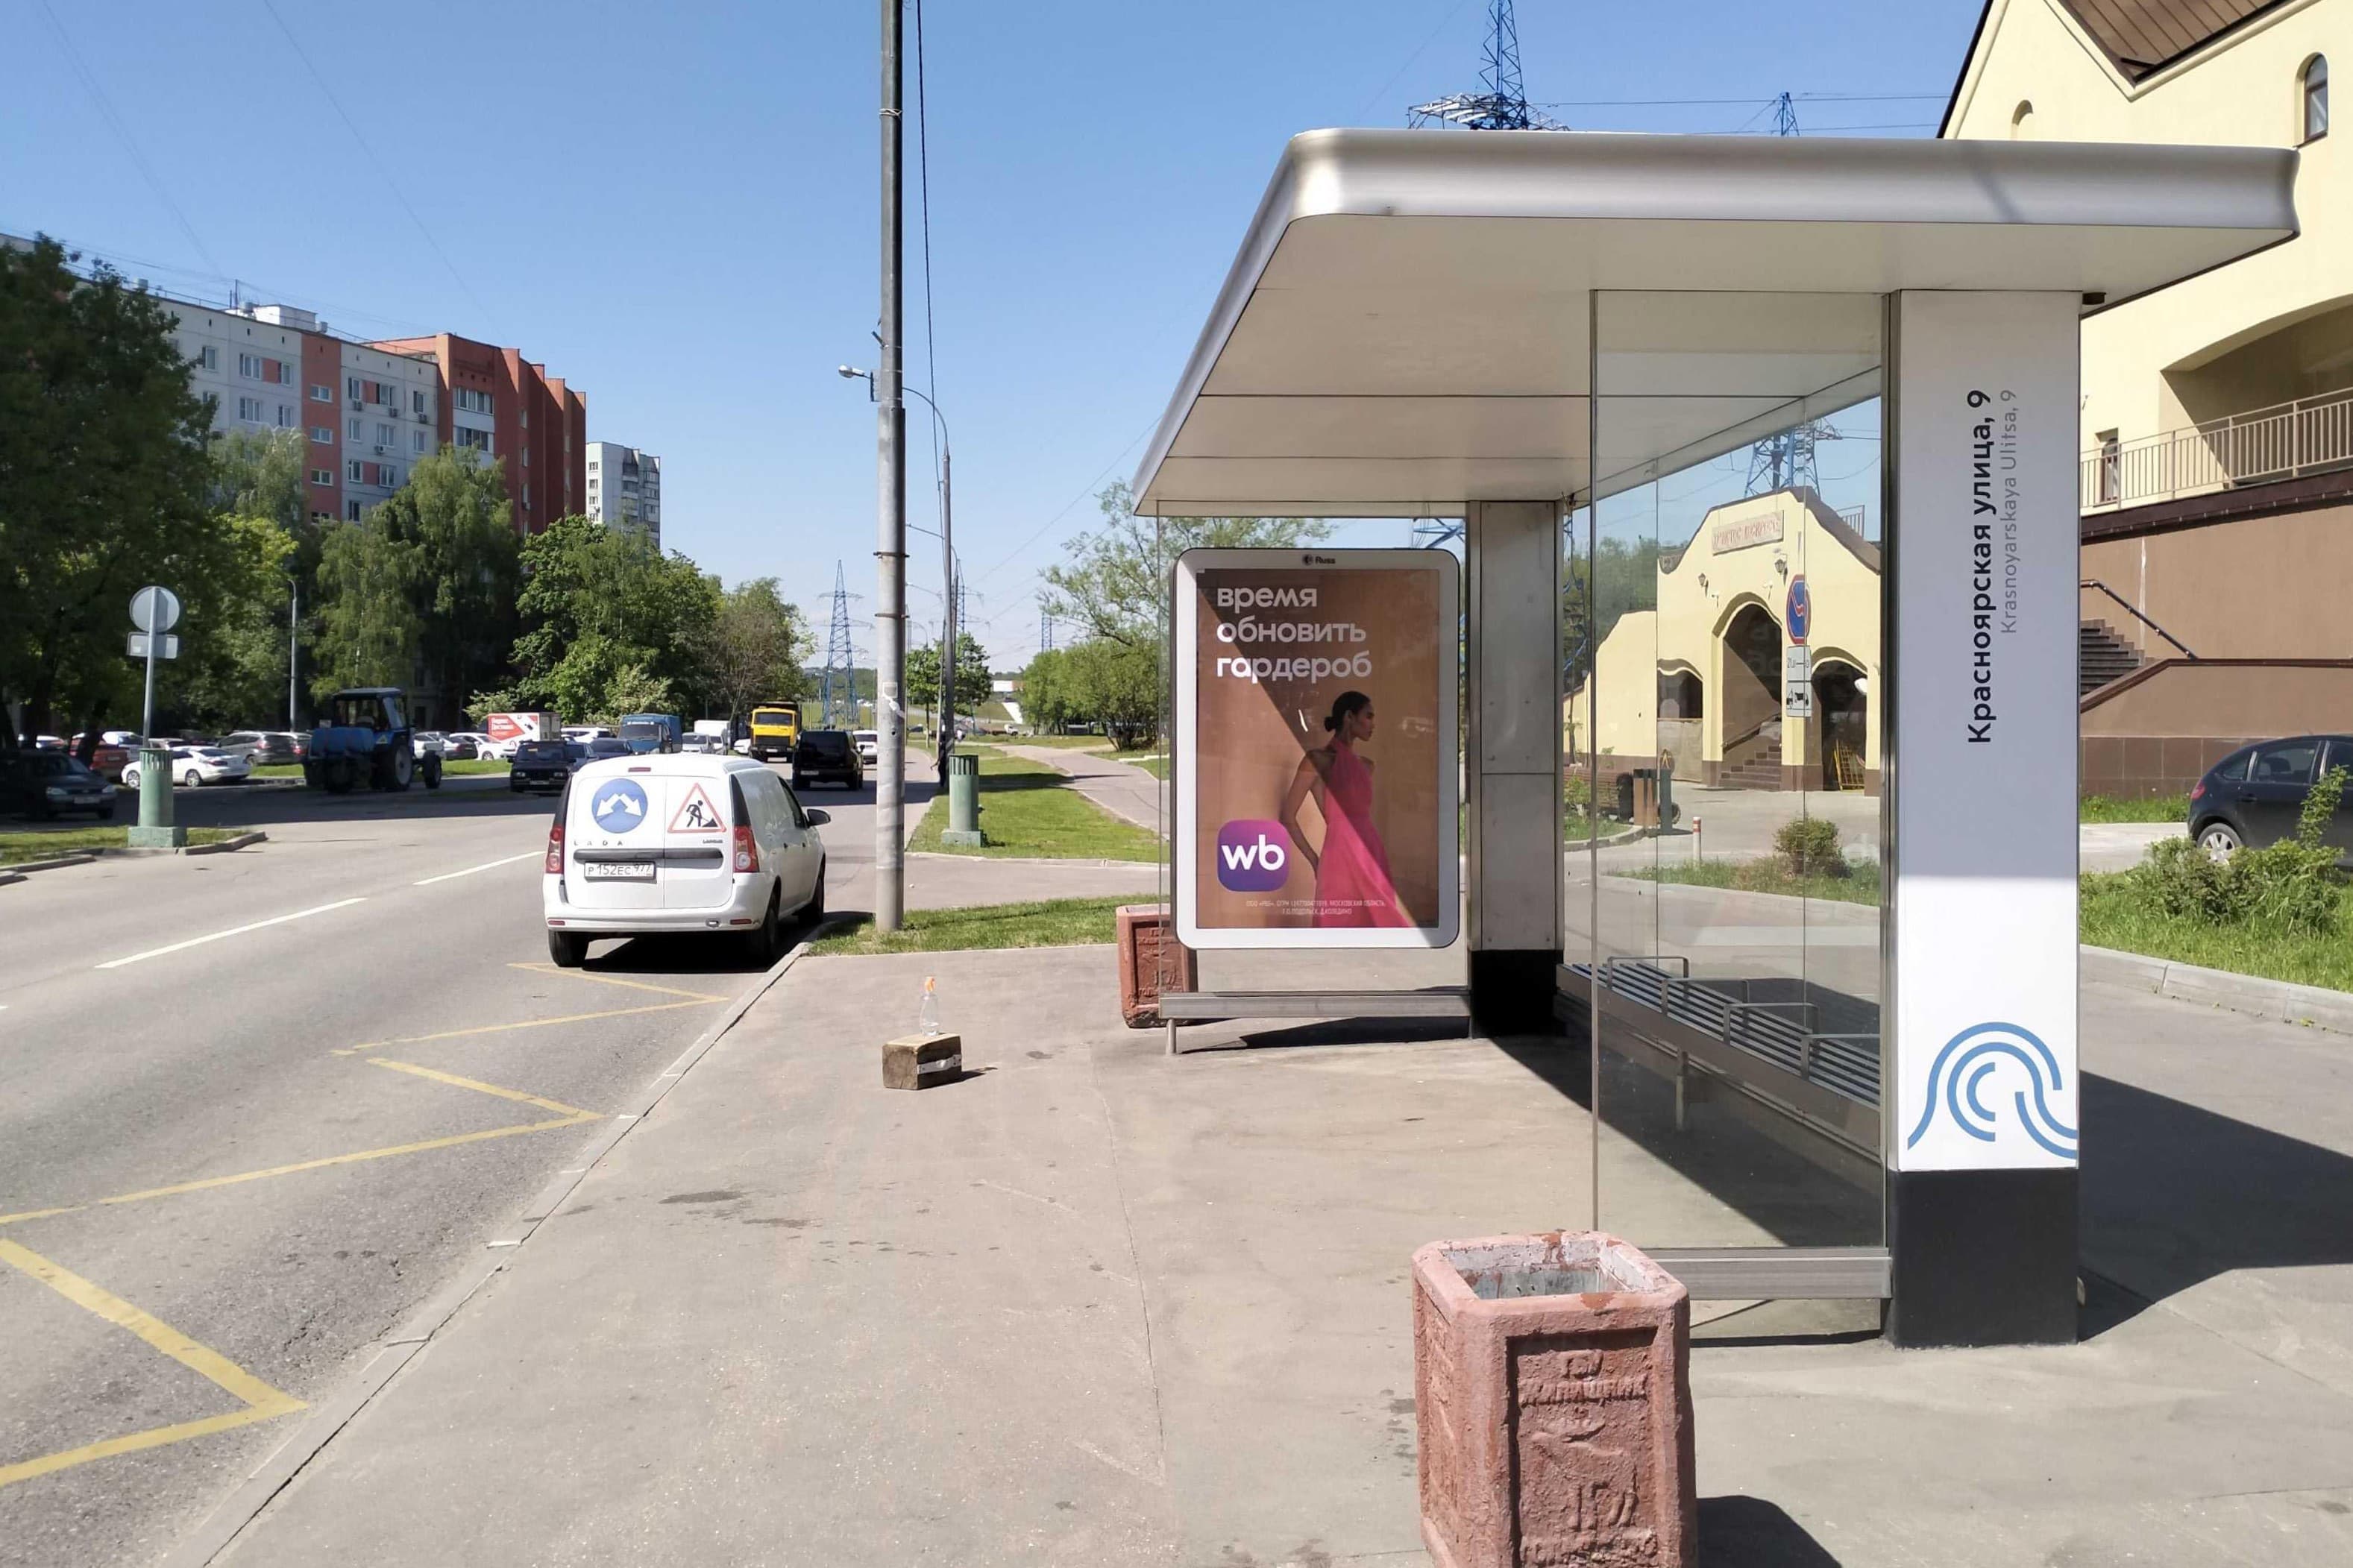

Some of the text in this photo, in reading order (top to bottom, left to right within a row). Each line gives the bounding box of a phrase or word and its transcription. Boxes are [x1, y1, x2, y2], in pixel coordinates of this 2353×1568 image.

[1999, 389, 2021, 633] Krasnoyarskaya Ulitsa, 9
[1967, 390, 1997, 743] Красноярская улица, 9
[1217, 588, 1317, 614] время
[1216, 615, 1366, 643] обновить
[1216, 650, 1372, 684] гардероб
[1221, 834, 1285, 871] wb
